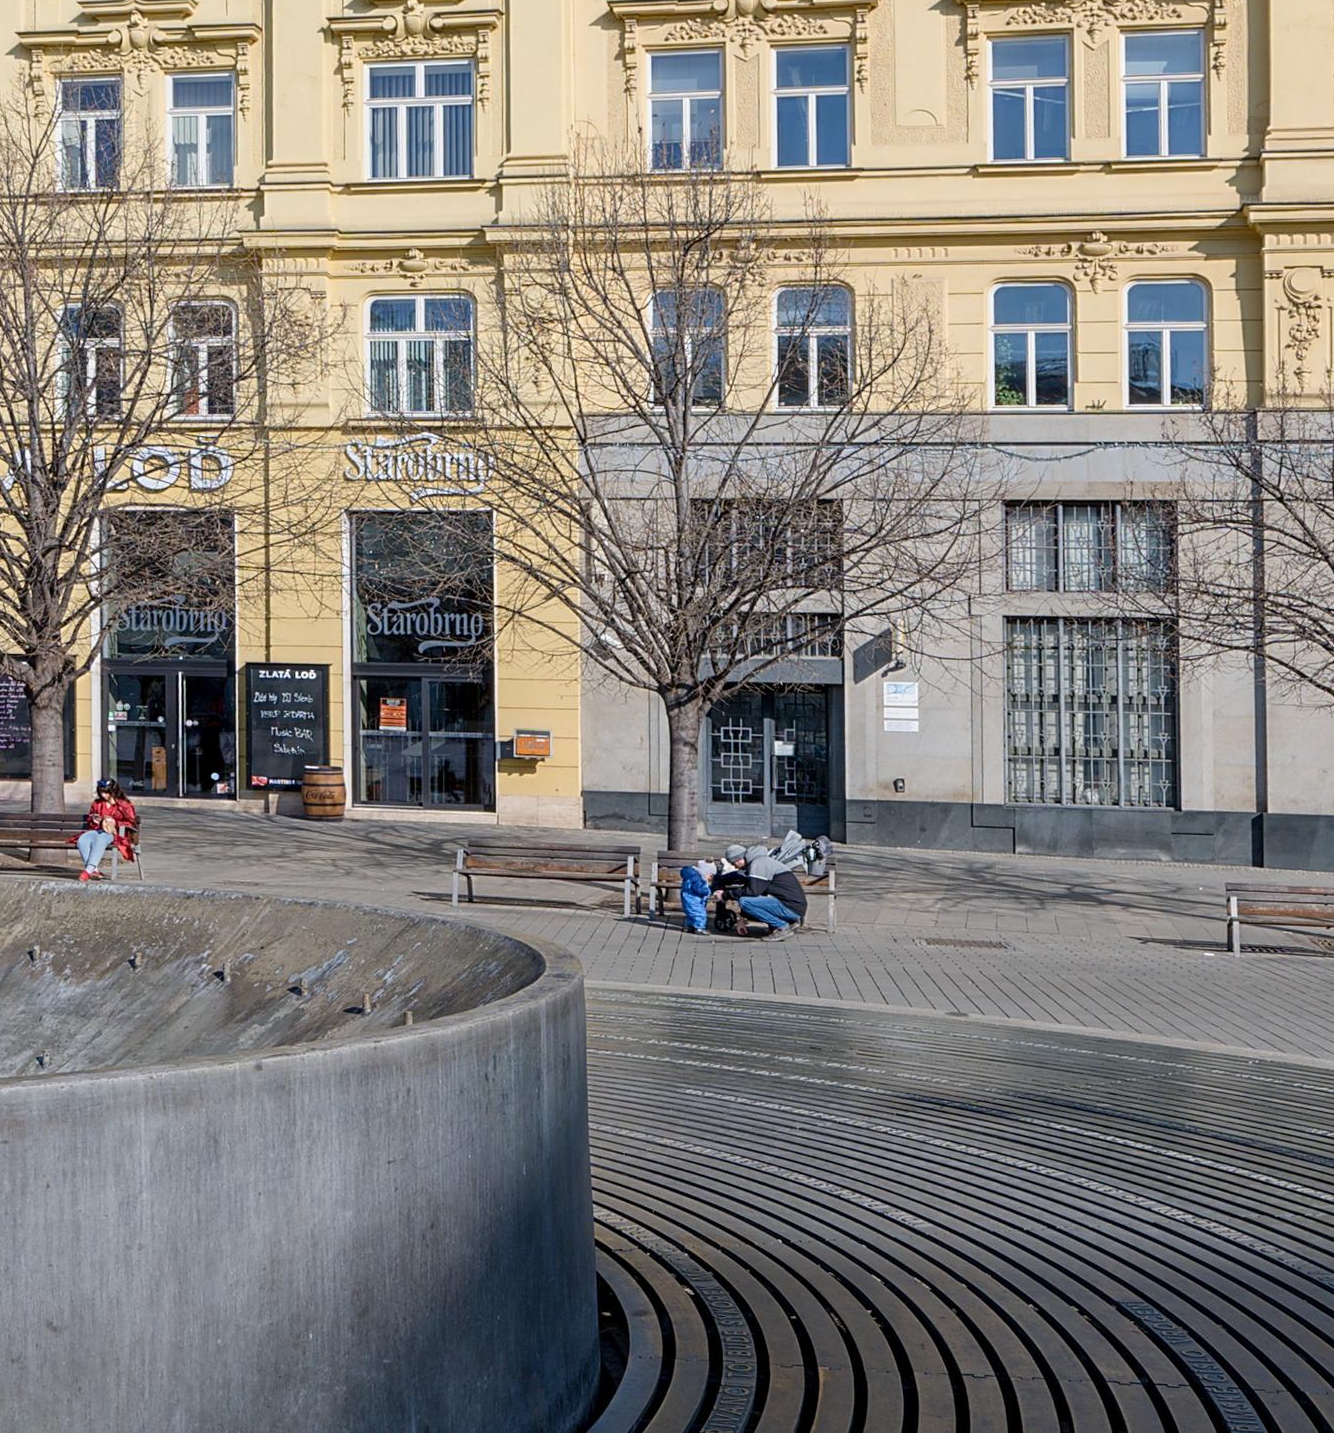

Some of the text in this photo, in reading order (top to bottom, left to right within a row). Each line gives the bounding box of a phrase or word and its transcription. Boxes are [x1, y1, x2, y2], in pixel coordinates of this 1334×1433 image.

[93, 434, 236, 492] LOĎ
[344, 432, 496, 503] Starobrno
[117, 594, 228, 647] Starobrno
[367, 597, 484, 653] Starobrno
[259, 669, 317, 679] ZLATÁ LOĎ
